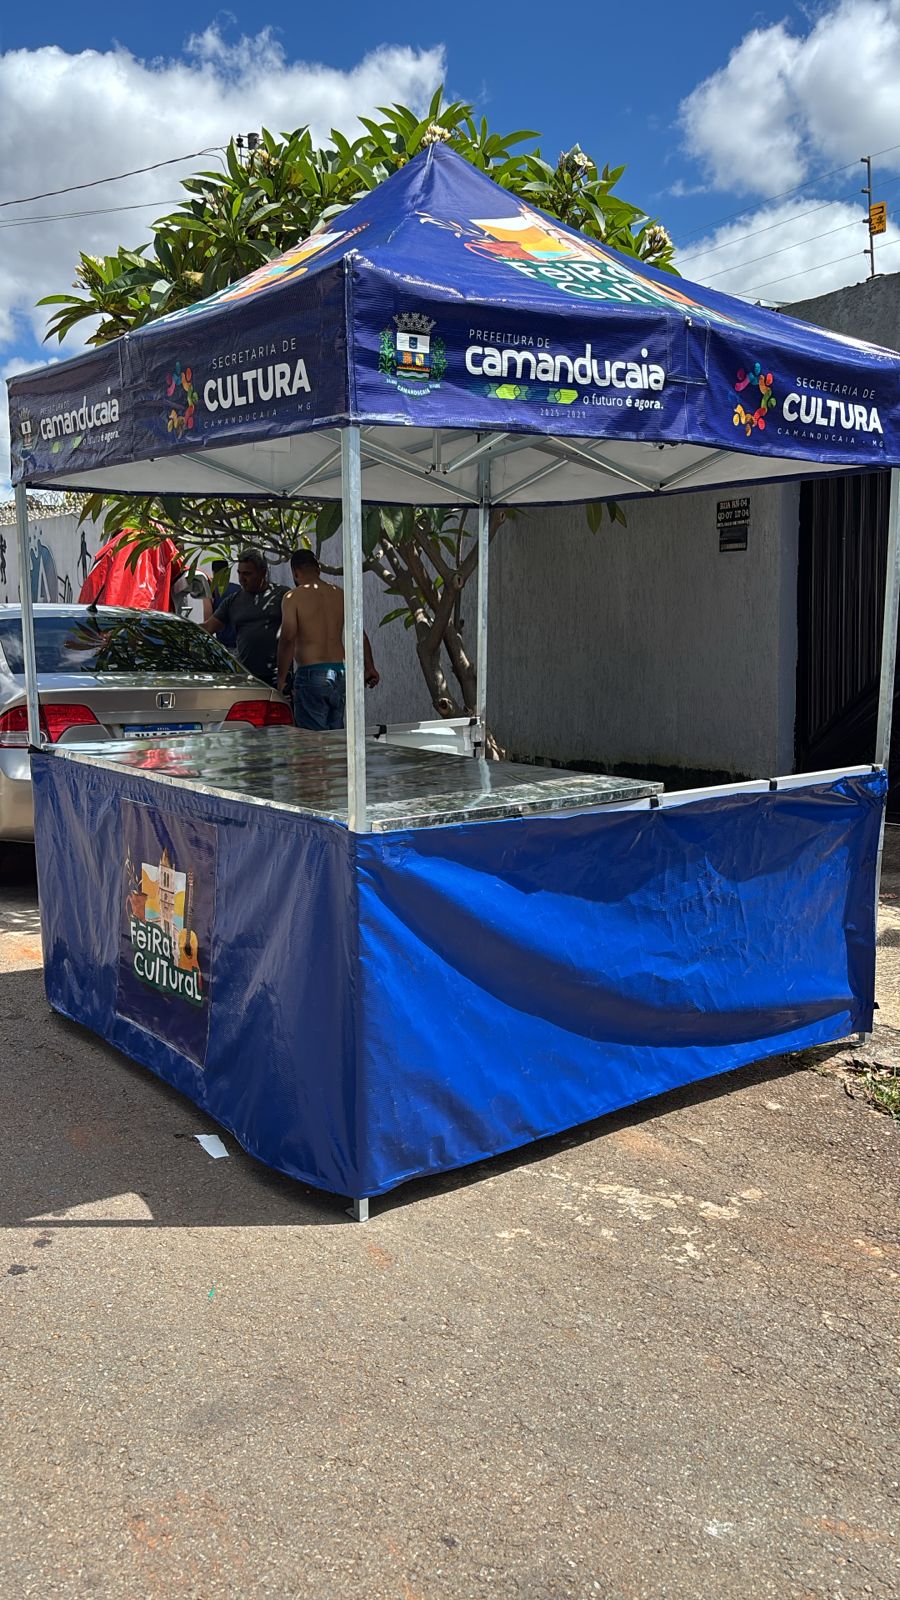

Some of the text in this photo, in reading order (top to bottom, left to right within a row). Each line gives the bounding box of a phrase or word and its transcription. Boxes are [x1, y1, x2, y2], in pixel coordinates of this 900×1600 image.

[212, 337, 297, 370] SECRETARIA DE
[468, 329, 550, 349] PREFEITURA DE
[465, 343, 666, 391] camanducaia
[203, 358, 312, 412] CULTURA
[796, 376, 876, 400] SECRETARIA DE
[40, 386, 120, 440] camanducaia
[203, 408, 277, 429] CAMANDUCAIA
[297, 402, 311, 412] MG
[582, 393, 665, 411] o futuro é agora.
[782, 392, 884, 434] CULTURA
[777, 427, 855, 444] CAMANDUCAIA
[872, 440, 884, 448] MG
[130, 921, 171, 959] FeiRa
